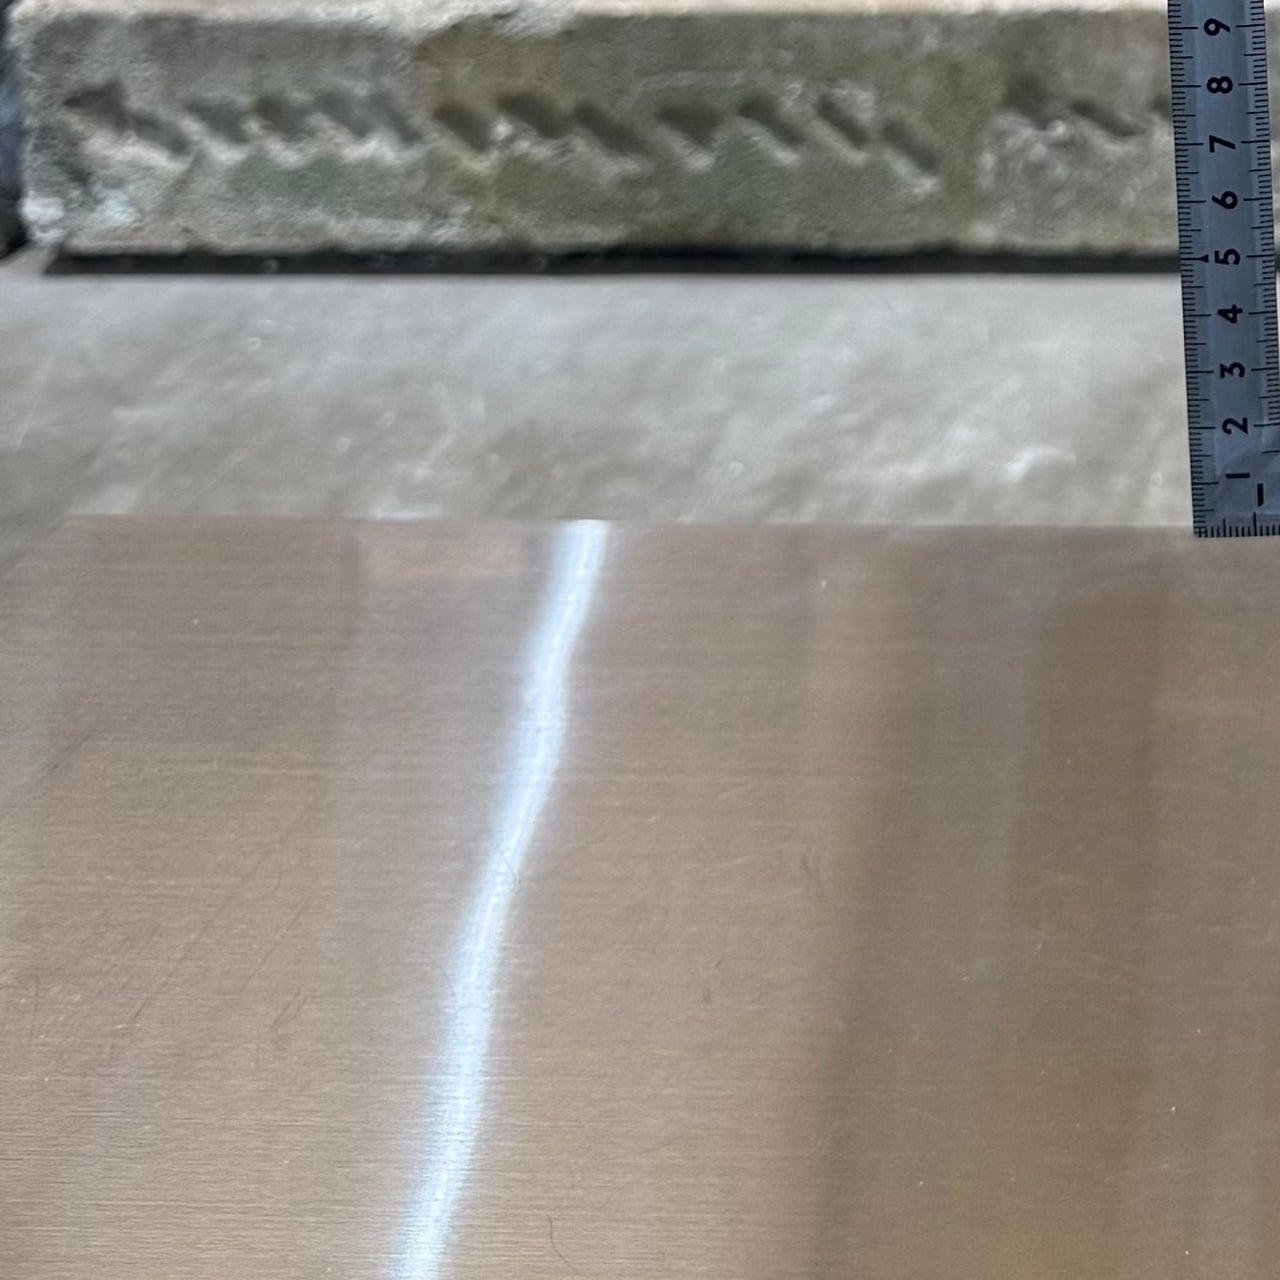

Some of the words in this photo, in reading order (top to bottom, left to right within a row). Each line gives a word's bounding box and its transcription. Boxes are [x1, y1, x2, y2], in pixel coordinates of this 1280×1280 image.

[1204, 18, 1231, 36] 9
[1207, 76, 1234, 94] 8
[1209, 135, 1236, 152] 7
[1212, 191, 1238, 210] 6
[1215, 248, 1241, 266] 5
[1217, 304, 1244, 324] 4
[1220, 361, 1246, 378] 3
[1222, 417, 1249, 435] 2
